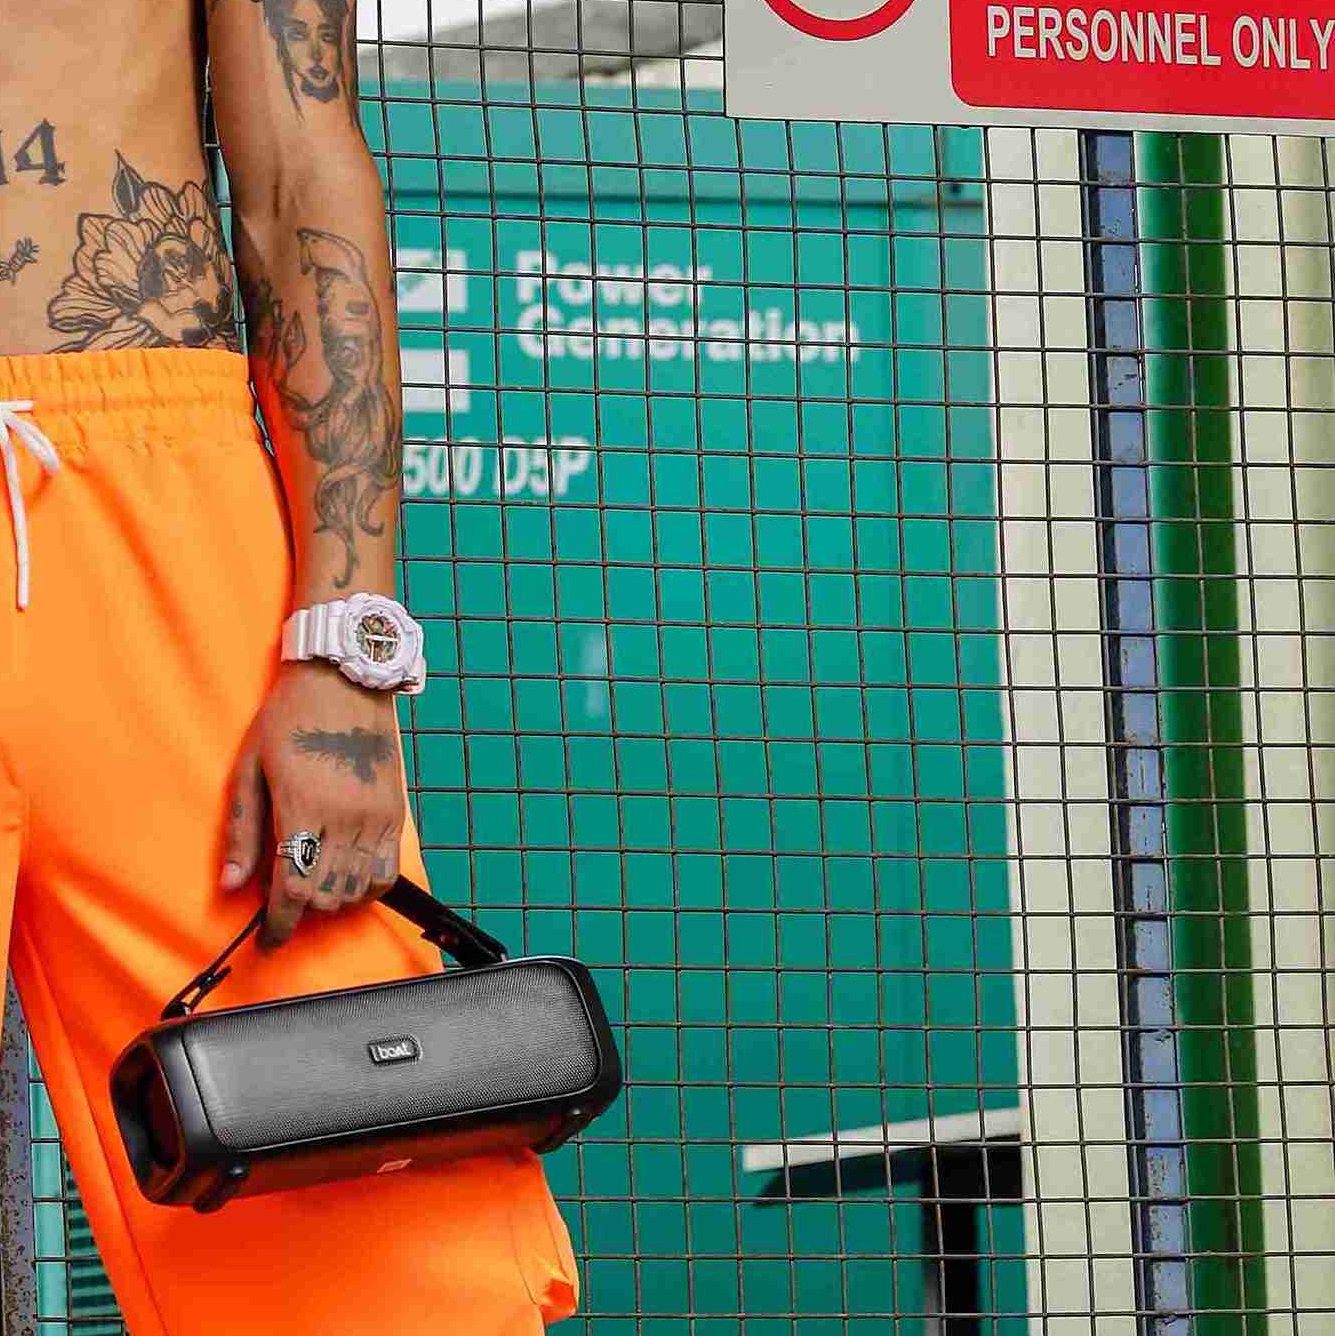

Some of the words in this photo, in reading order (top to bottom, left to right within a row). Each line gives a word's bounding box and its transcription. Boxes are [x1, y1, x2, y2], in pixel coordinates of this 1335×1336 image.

[987, 6, 1222, 67] PERSONNEL
[1232, 16, 1334, 70] ONLY
[517, 250, 713, 306] Power
[517, 305, 862, 362] Generation
